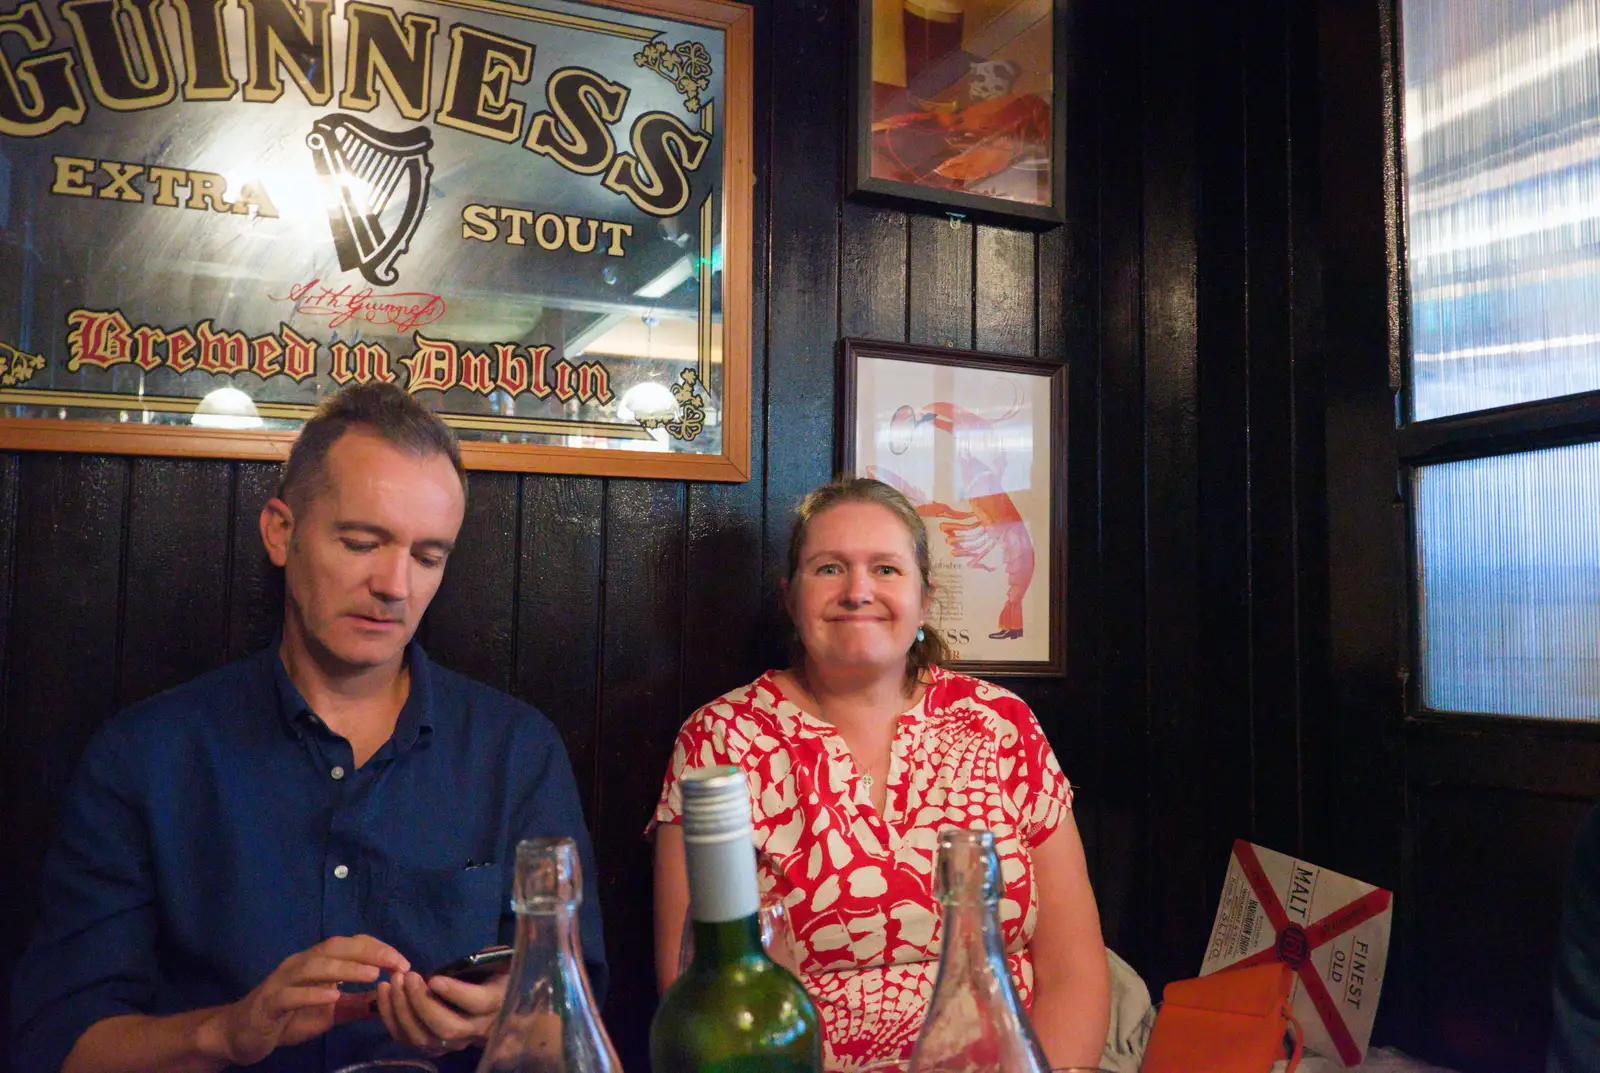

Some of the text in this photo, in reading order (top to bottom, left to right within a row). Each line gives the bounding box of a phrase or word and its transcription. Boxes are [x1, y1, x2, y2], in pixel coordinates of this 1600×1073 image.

[0, 0, 712, 217] GUINNESS
[52, 155, 279, 219] EXTRA
[462, 203, 633, 257] STOUT
[65, 308, 616, 407] Brewed in Dublin
[1290, 865, 1313, 919] MALT
[1332, 950, 1346, 982] OLD
[1348, 940, 1369, 1010] FINEST
